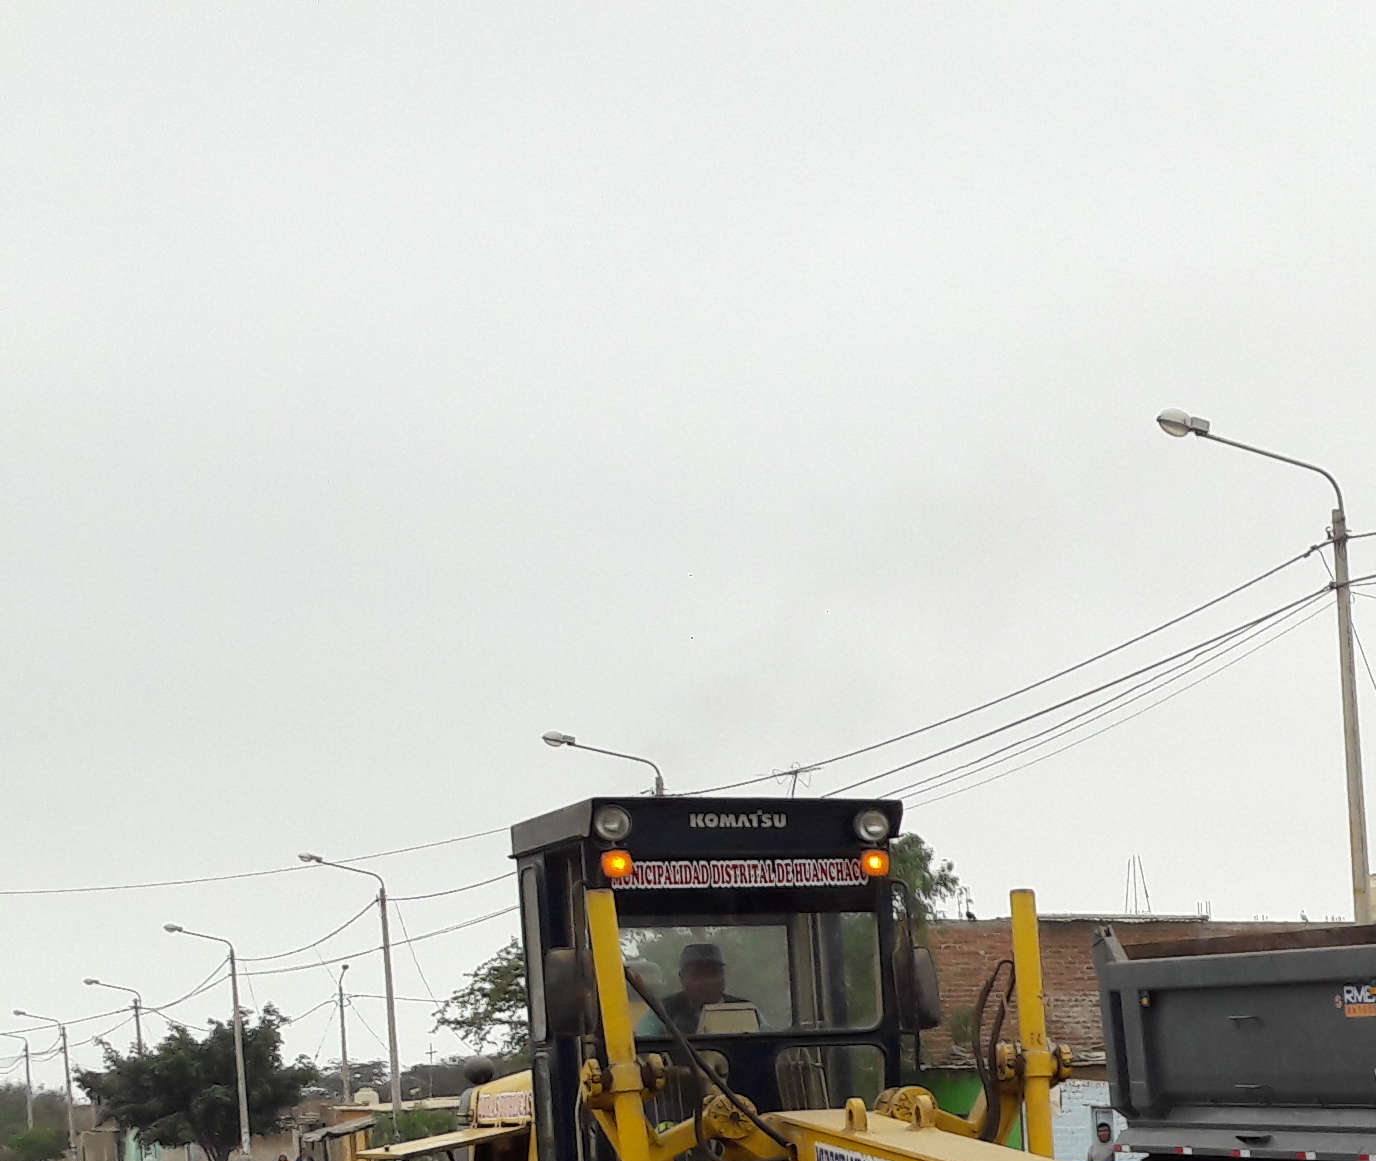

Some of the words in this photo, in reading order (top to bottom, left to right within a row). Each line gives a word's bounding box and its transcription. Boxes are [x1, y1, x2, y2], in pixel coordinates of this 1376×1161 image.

[690, 809, 787, 828] KOMATSU
[711, 862, 775, 884] DISTRITAL
[776, 862, 793, 883] DE
